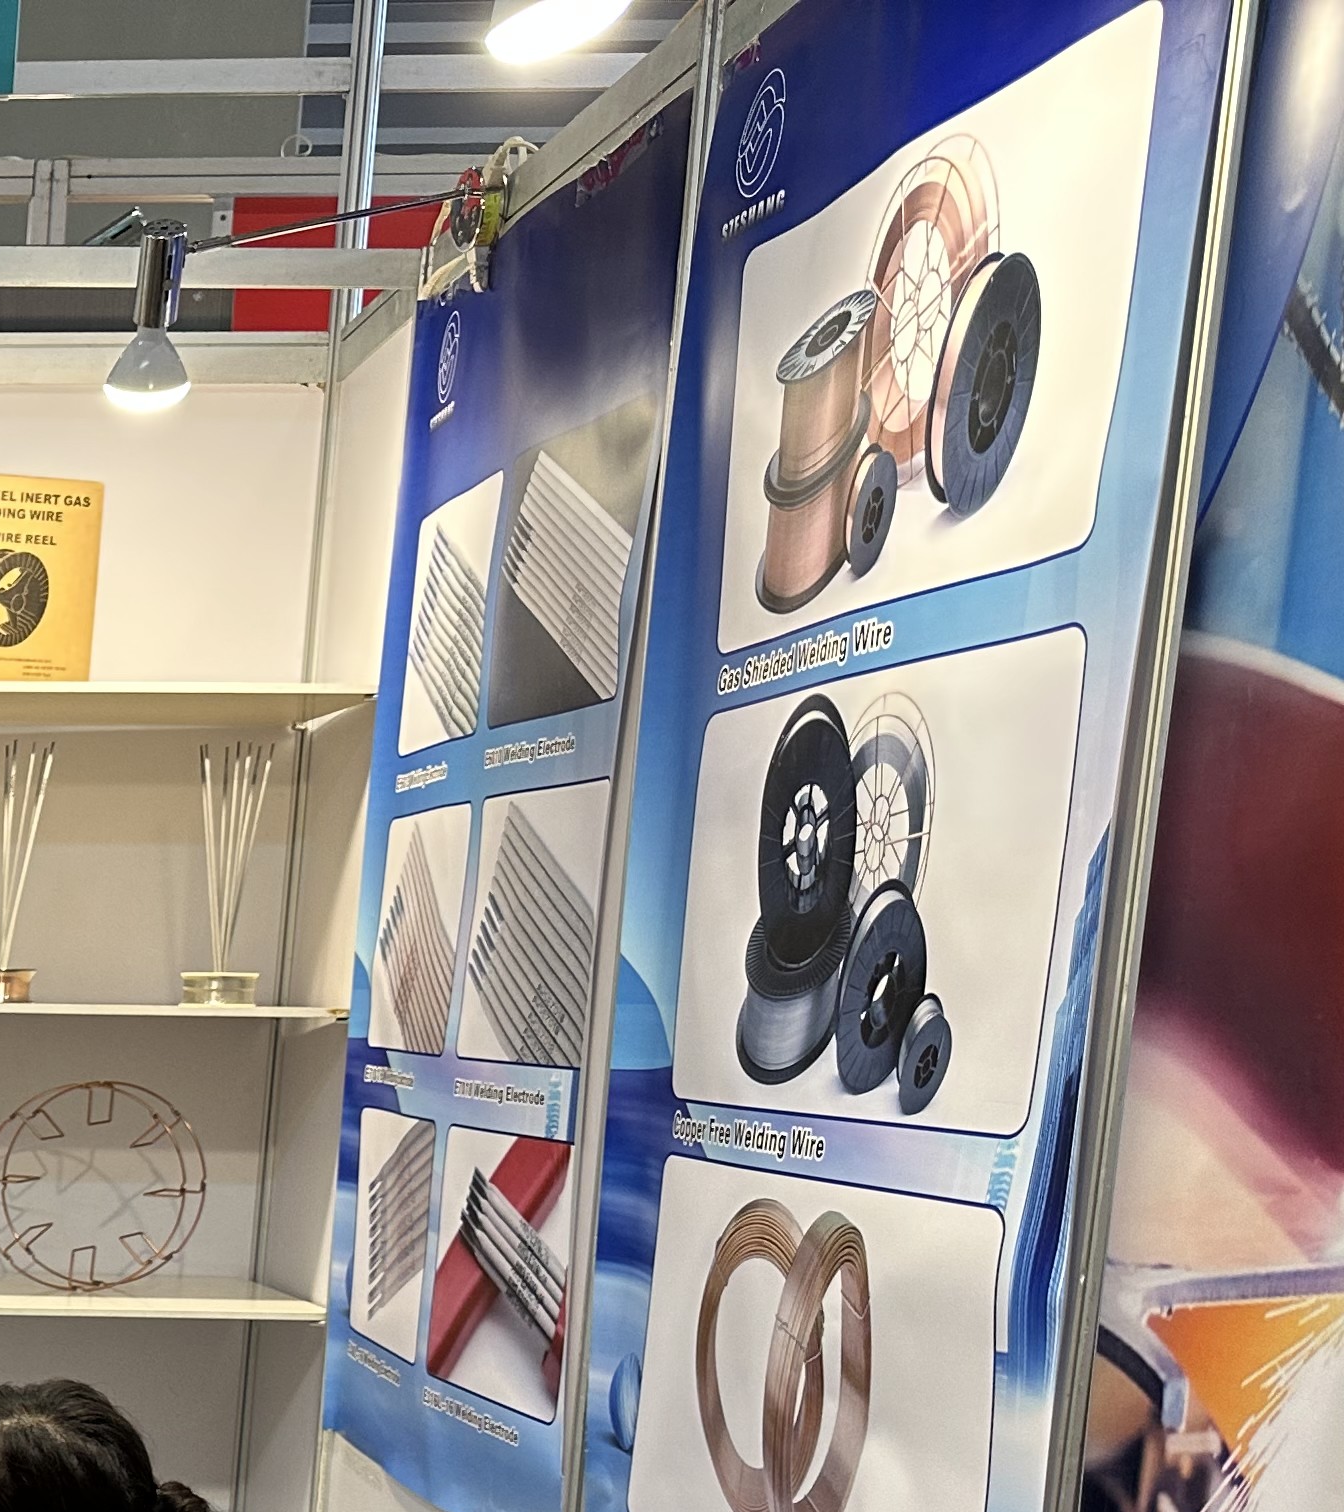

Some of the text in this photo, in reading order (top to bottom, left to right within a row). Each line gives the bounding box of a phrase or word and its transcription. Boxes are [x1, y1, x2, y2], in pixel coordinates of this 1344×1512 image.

[20, 491, 60, 506] INERT
[63, 495, 91, 508] GAS
[29, 509, 63, 523] WIRE
[25, 534, 57, 546] REEL
[718, 620, 892, 693] Gas Shielded Welding Wire
[536, 734, 575, 758] Electrode
[506, 1085, 546, 1106] Electrode
[673, 1111, 825, 1160] Copper Free Welding Wire
